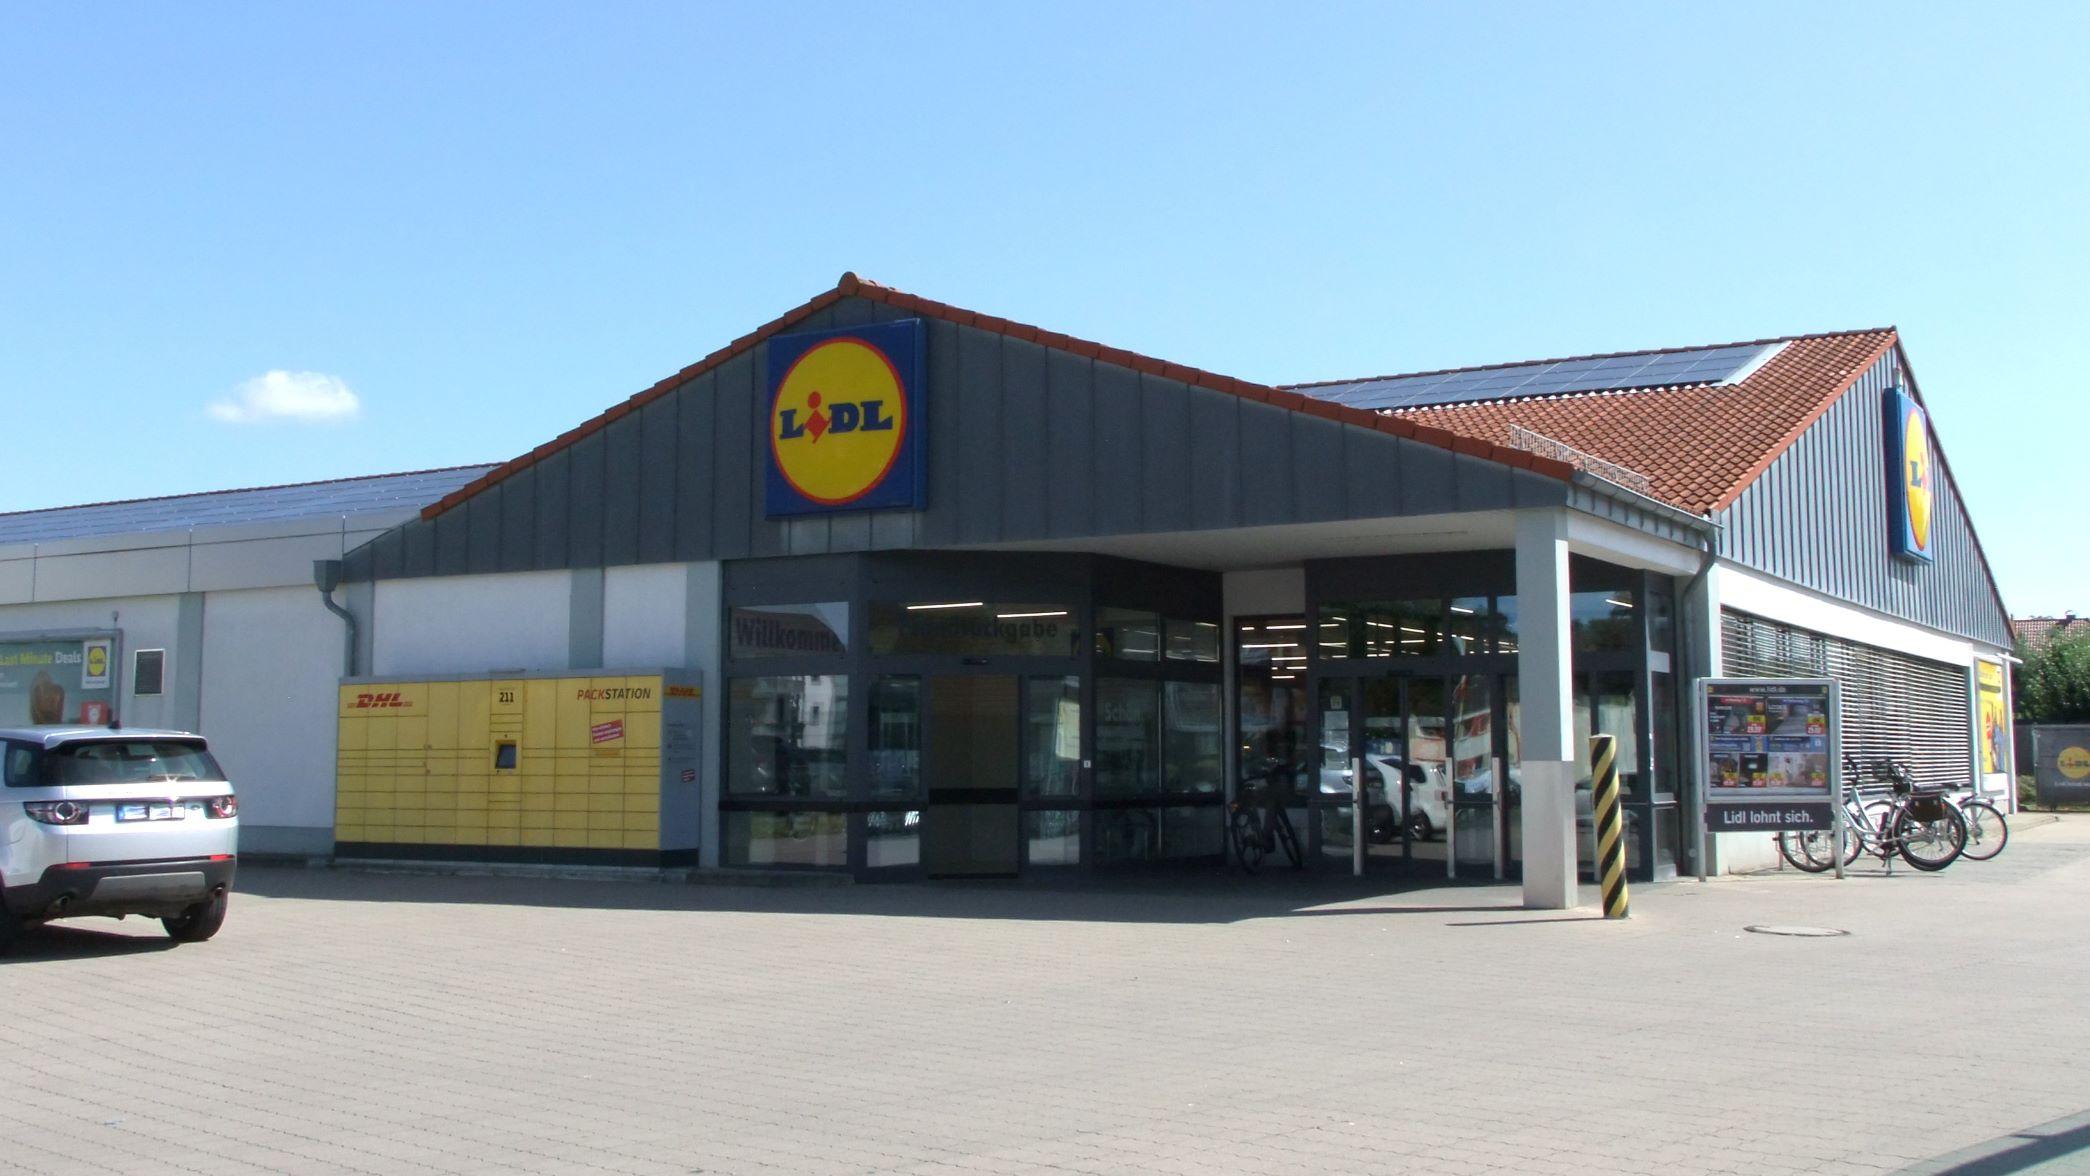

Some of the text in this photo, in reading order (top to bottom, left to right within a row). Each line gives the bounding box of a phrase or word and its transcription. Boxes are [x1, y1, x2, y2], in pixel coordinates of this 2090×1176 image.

[779, 391, 893, 444] LIDL
[20, 652, 52, 665] Minute
[55, 651, 82, 664] Deals
[356, 693, 402, 708] DHL
[499, 691, 514, 703] 211
[577, 688, 651, 700] PACKSTATION
[1723, 810, 1814, 824] Lidl lohnt sich.
